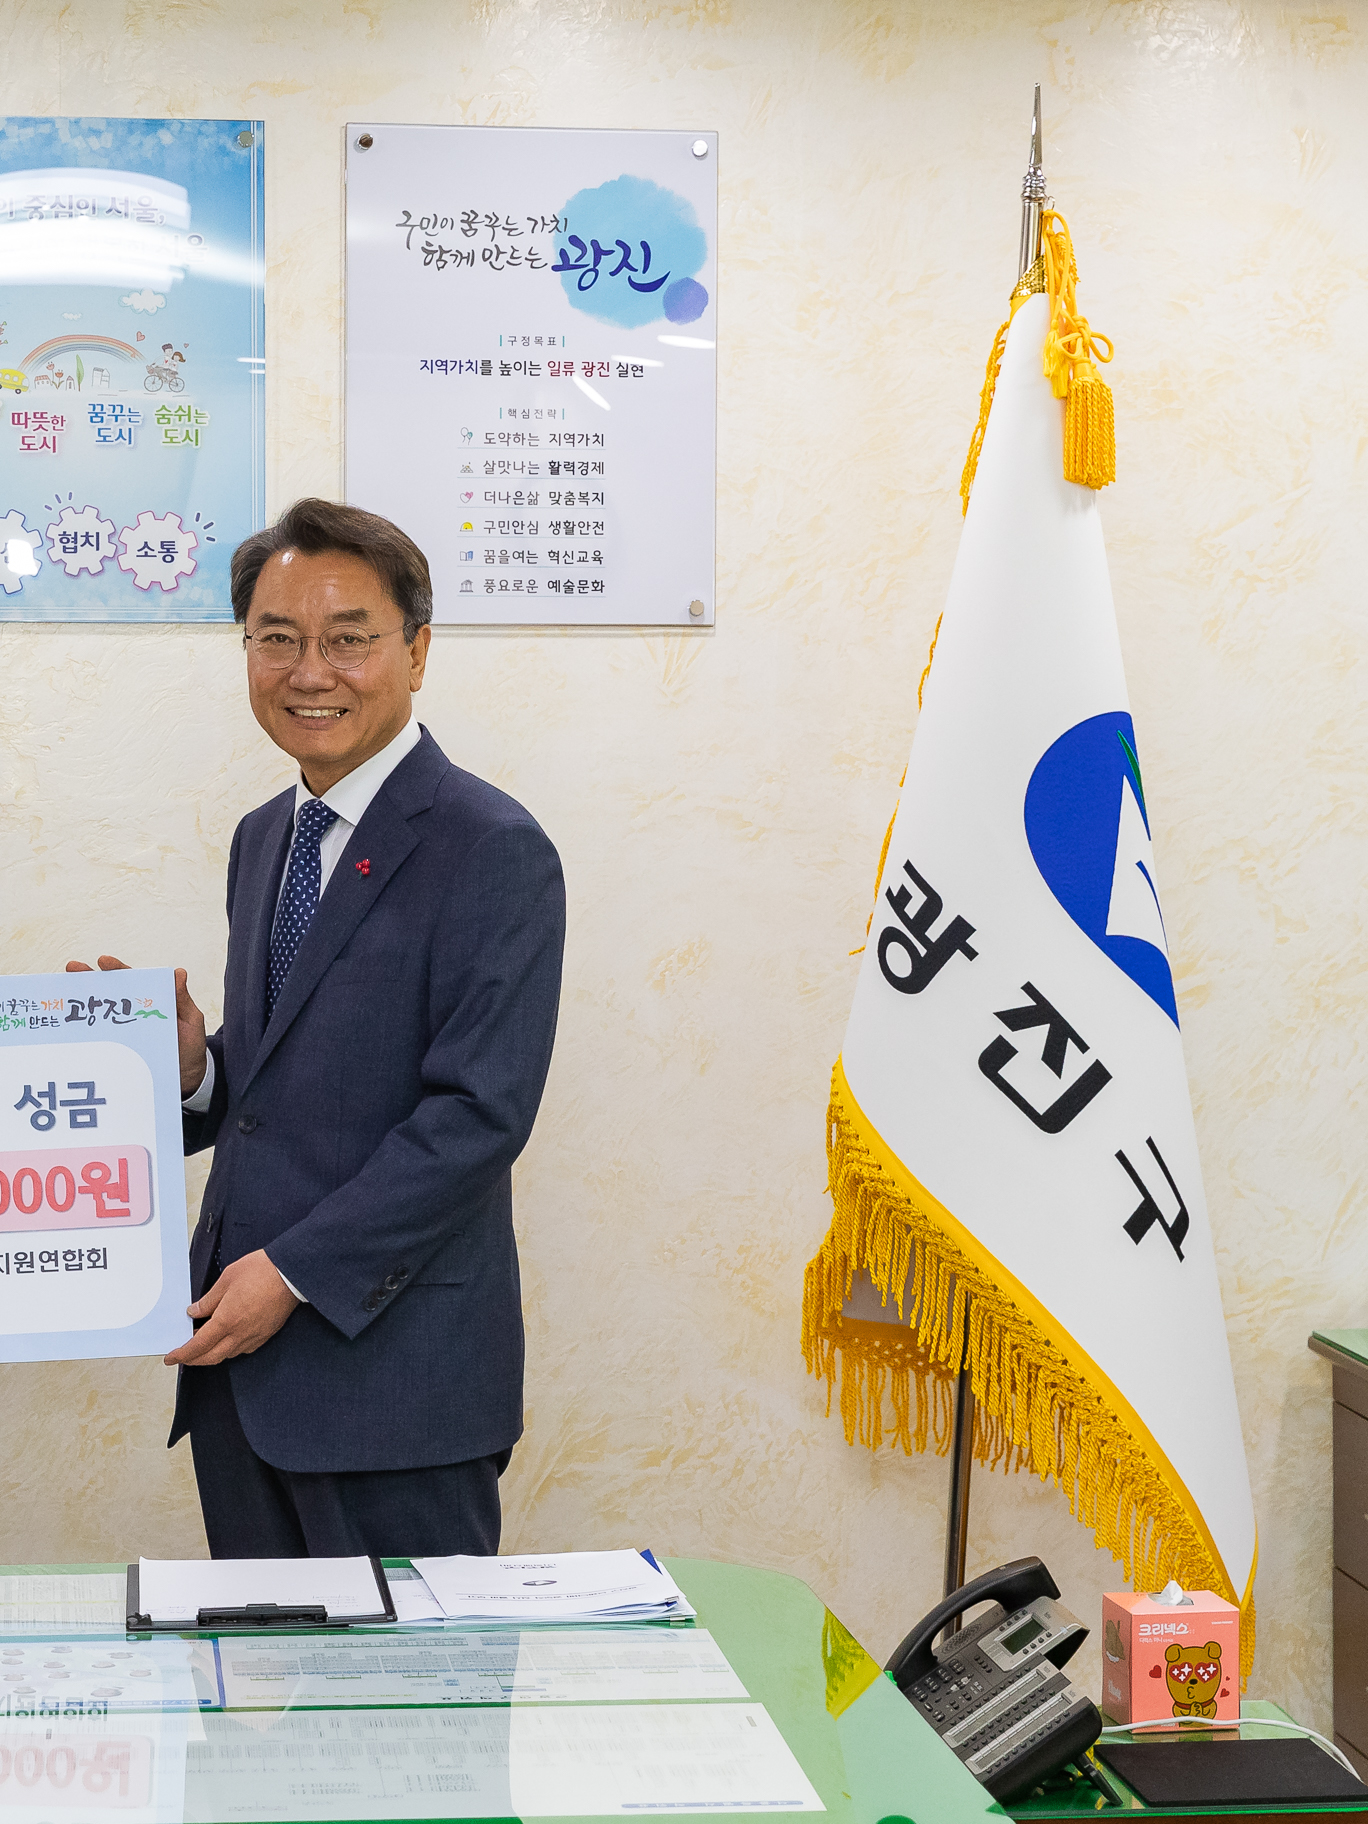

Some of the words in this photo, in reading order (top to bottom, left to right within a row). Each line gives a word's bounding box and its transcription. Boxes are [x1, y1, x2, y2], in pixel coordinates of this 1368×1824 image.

[24, 194, 98, 221] 중심인
[396, 210, 454, 251] 구민이
[460, 211, 525, 242] 꿈꾸는
[527, 215, 568, 235] 가치
[421, 241, 475, 271] 함께
[481, 246, 548, 270] 만드는
[551, 234, 671, 293] 광진
[419, 358, 493, 377] 지역가치를
[498, 360, 542, 378] 높이는
[547, 360, 576, 378] 일류
[581, 361, 611, 378] 광진
[615, 362, 645, 378] 실현
[11, 411, 67, 432] 따뜻한
[88, 403, 142, 424] 꿈꾸는
[155, 405, 208, 426] 숨쉬는
[19, 435, 58, 454] 도시
[95, 427, 134, 446] 도시
[162, 428, 200, 447] 도시
[484, 432, 540, 448] 도약하는
[548, 432, 605, 448] 지역가치
[484, 460, 540, 476] 살맛나는
[548, 460, 605, 476] 활력경제
[484, 490, 540, 506] 더나은삶
[548, 490, 605, 506] 맞춤복지
[484, 519, 540, 536] 구민안심
[548, 519, 605, 536] 생활안전
[58, 531, 100, 553] 협치
[136, 540, 179, 564] 소통
[484, 549, 540, 565] 꿈을여는
[548, 549, 605, 565] 혁신교육
[484, 578, 540, 595] 풍요로운
[548, 578, 605, 595] 예술문화
[6, 998, 40, 1016] 꿈꾸는
[41, 998, 64, 1011] 가치
[29, 1016, 60, 1029] 만드는
[65, 996, 137, 1026] 광진
[877, 858, 1190, 1263] 광진구
[14, 1080, 106, 1133] 성금
[1139, 1623, 1189, 1636] 크리넥스
